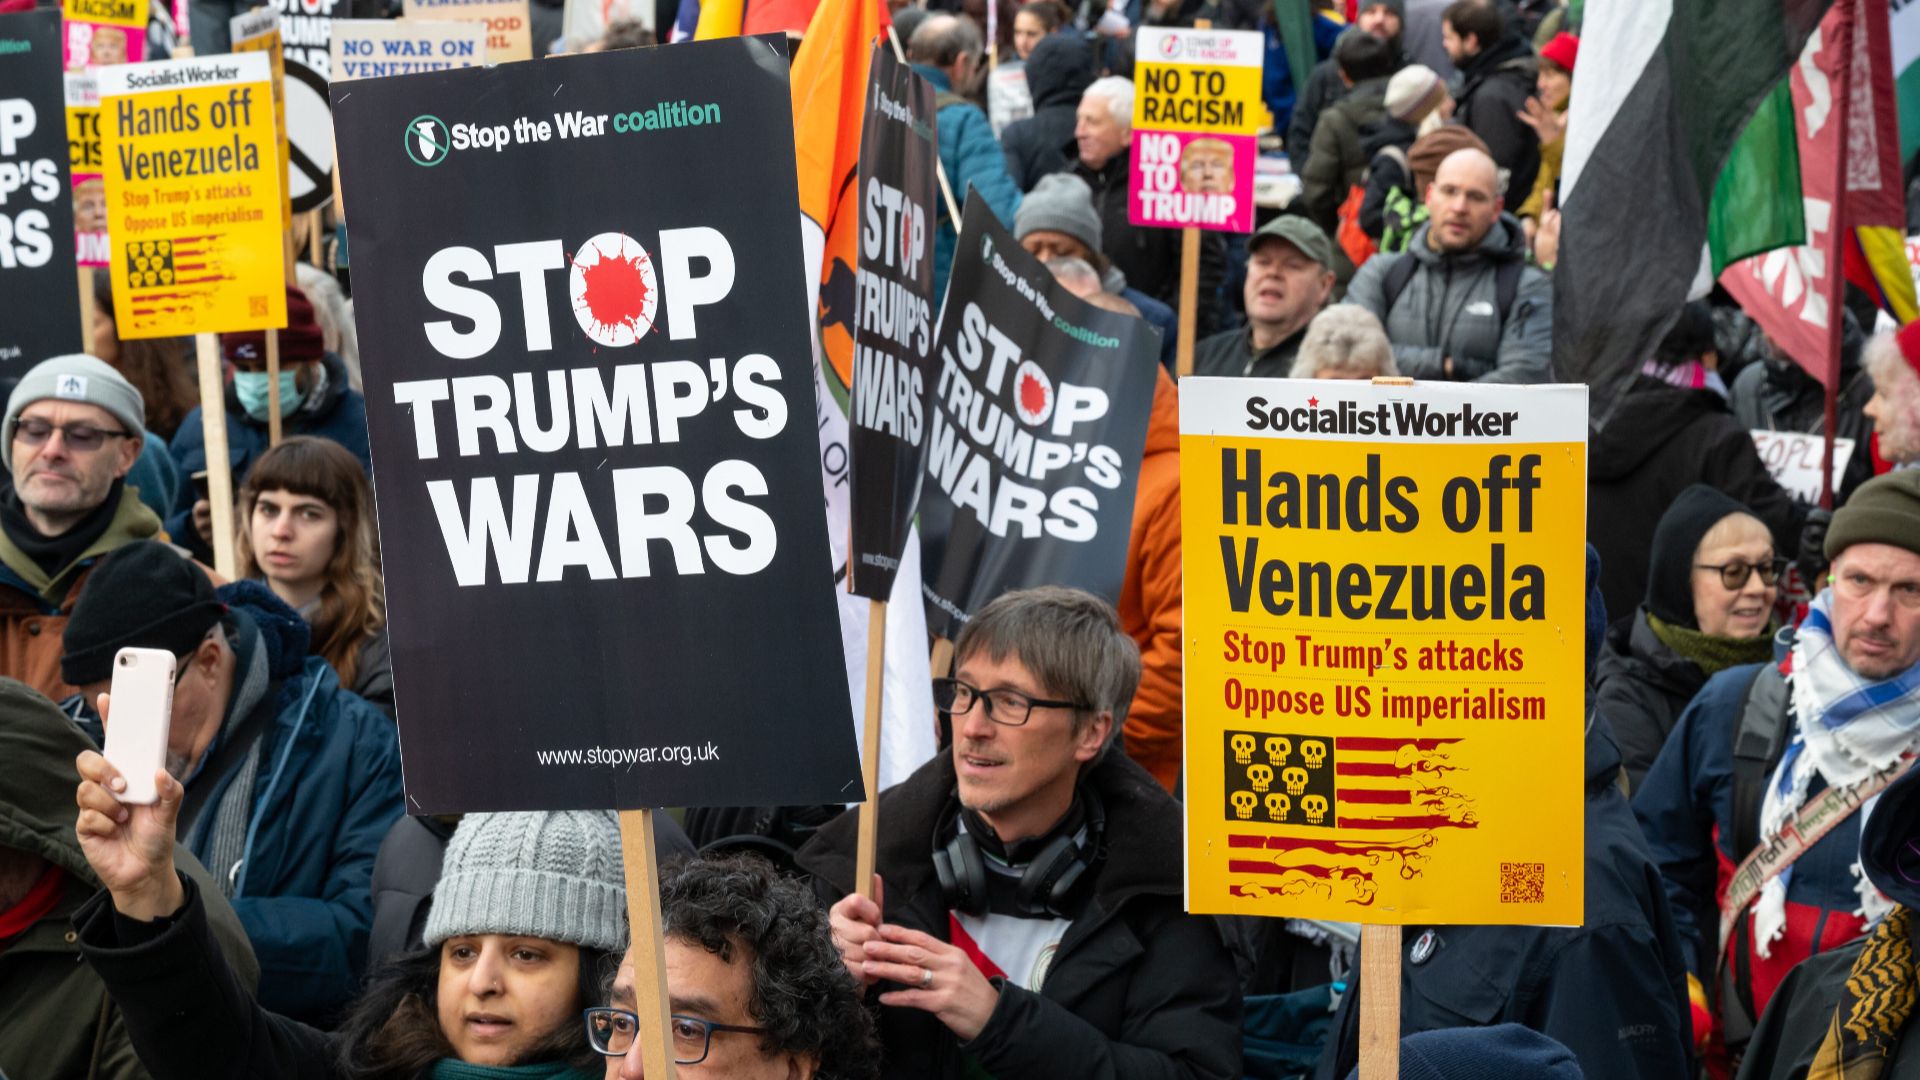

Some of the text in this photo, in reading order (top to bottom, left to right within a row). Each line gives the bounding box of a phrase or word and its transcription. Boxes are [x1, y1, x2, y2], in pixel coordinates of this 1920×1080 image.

[343, 40, 475, 56] NO WAR ON
[486, 35, 512, 49] IL
[1145, 68, 1225, 97] NO TO
[118, 87, 253, 138] Hands off
[451, 100, 722, 153] Stop the War coalition
[1143, 97, 1244, 126] RACISM
[69, 140, 102, 166] CIS
[118, 133, 260, 182] Venezuela
[1139, 132, 1181, 165] NO
[123, 190, 150, 210] Stop
[205, 181, 253, 203] attacks
[1139, 163, 1178, 193] TO
[124, 206, 264, 233] Oppose US imperialism
[863, 176, 925, 282] STOP
[1138, 190, 1237, 225] TRUMP
[0, 209, 54, 268] RS
[422, 226, 736, 360] STOP
[992, 252, 1018, 286] Stop
[1016, 276, 1036, 302] the
[1053, 315, 1120, 349] coalition
[957, 301, 1110, 437] STOP
[856, 343, 924, 447] WARS
[928, 405, 1100, 543] WARS
[1221, 447, 1542, 534] Hands off
[426, 459, 778, 588] WARS
[1218, 535, 1546, 622] Venezuela
[1223, 630, 1524, 678] Stop Trump's attacks
[1224, 677, 1546, 727] Oppose US imperialism
[536, 740, 720, 769] www.stopwar.org.uk
